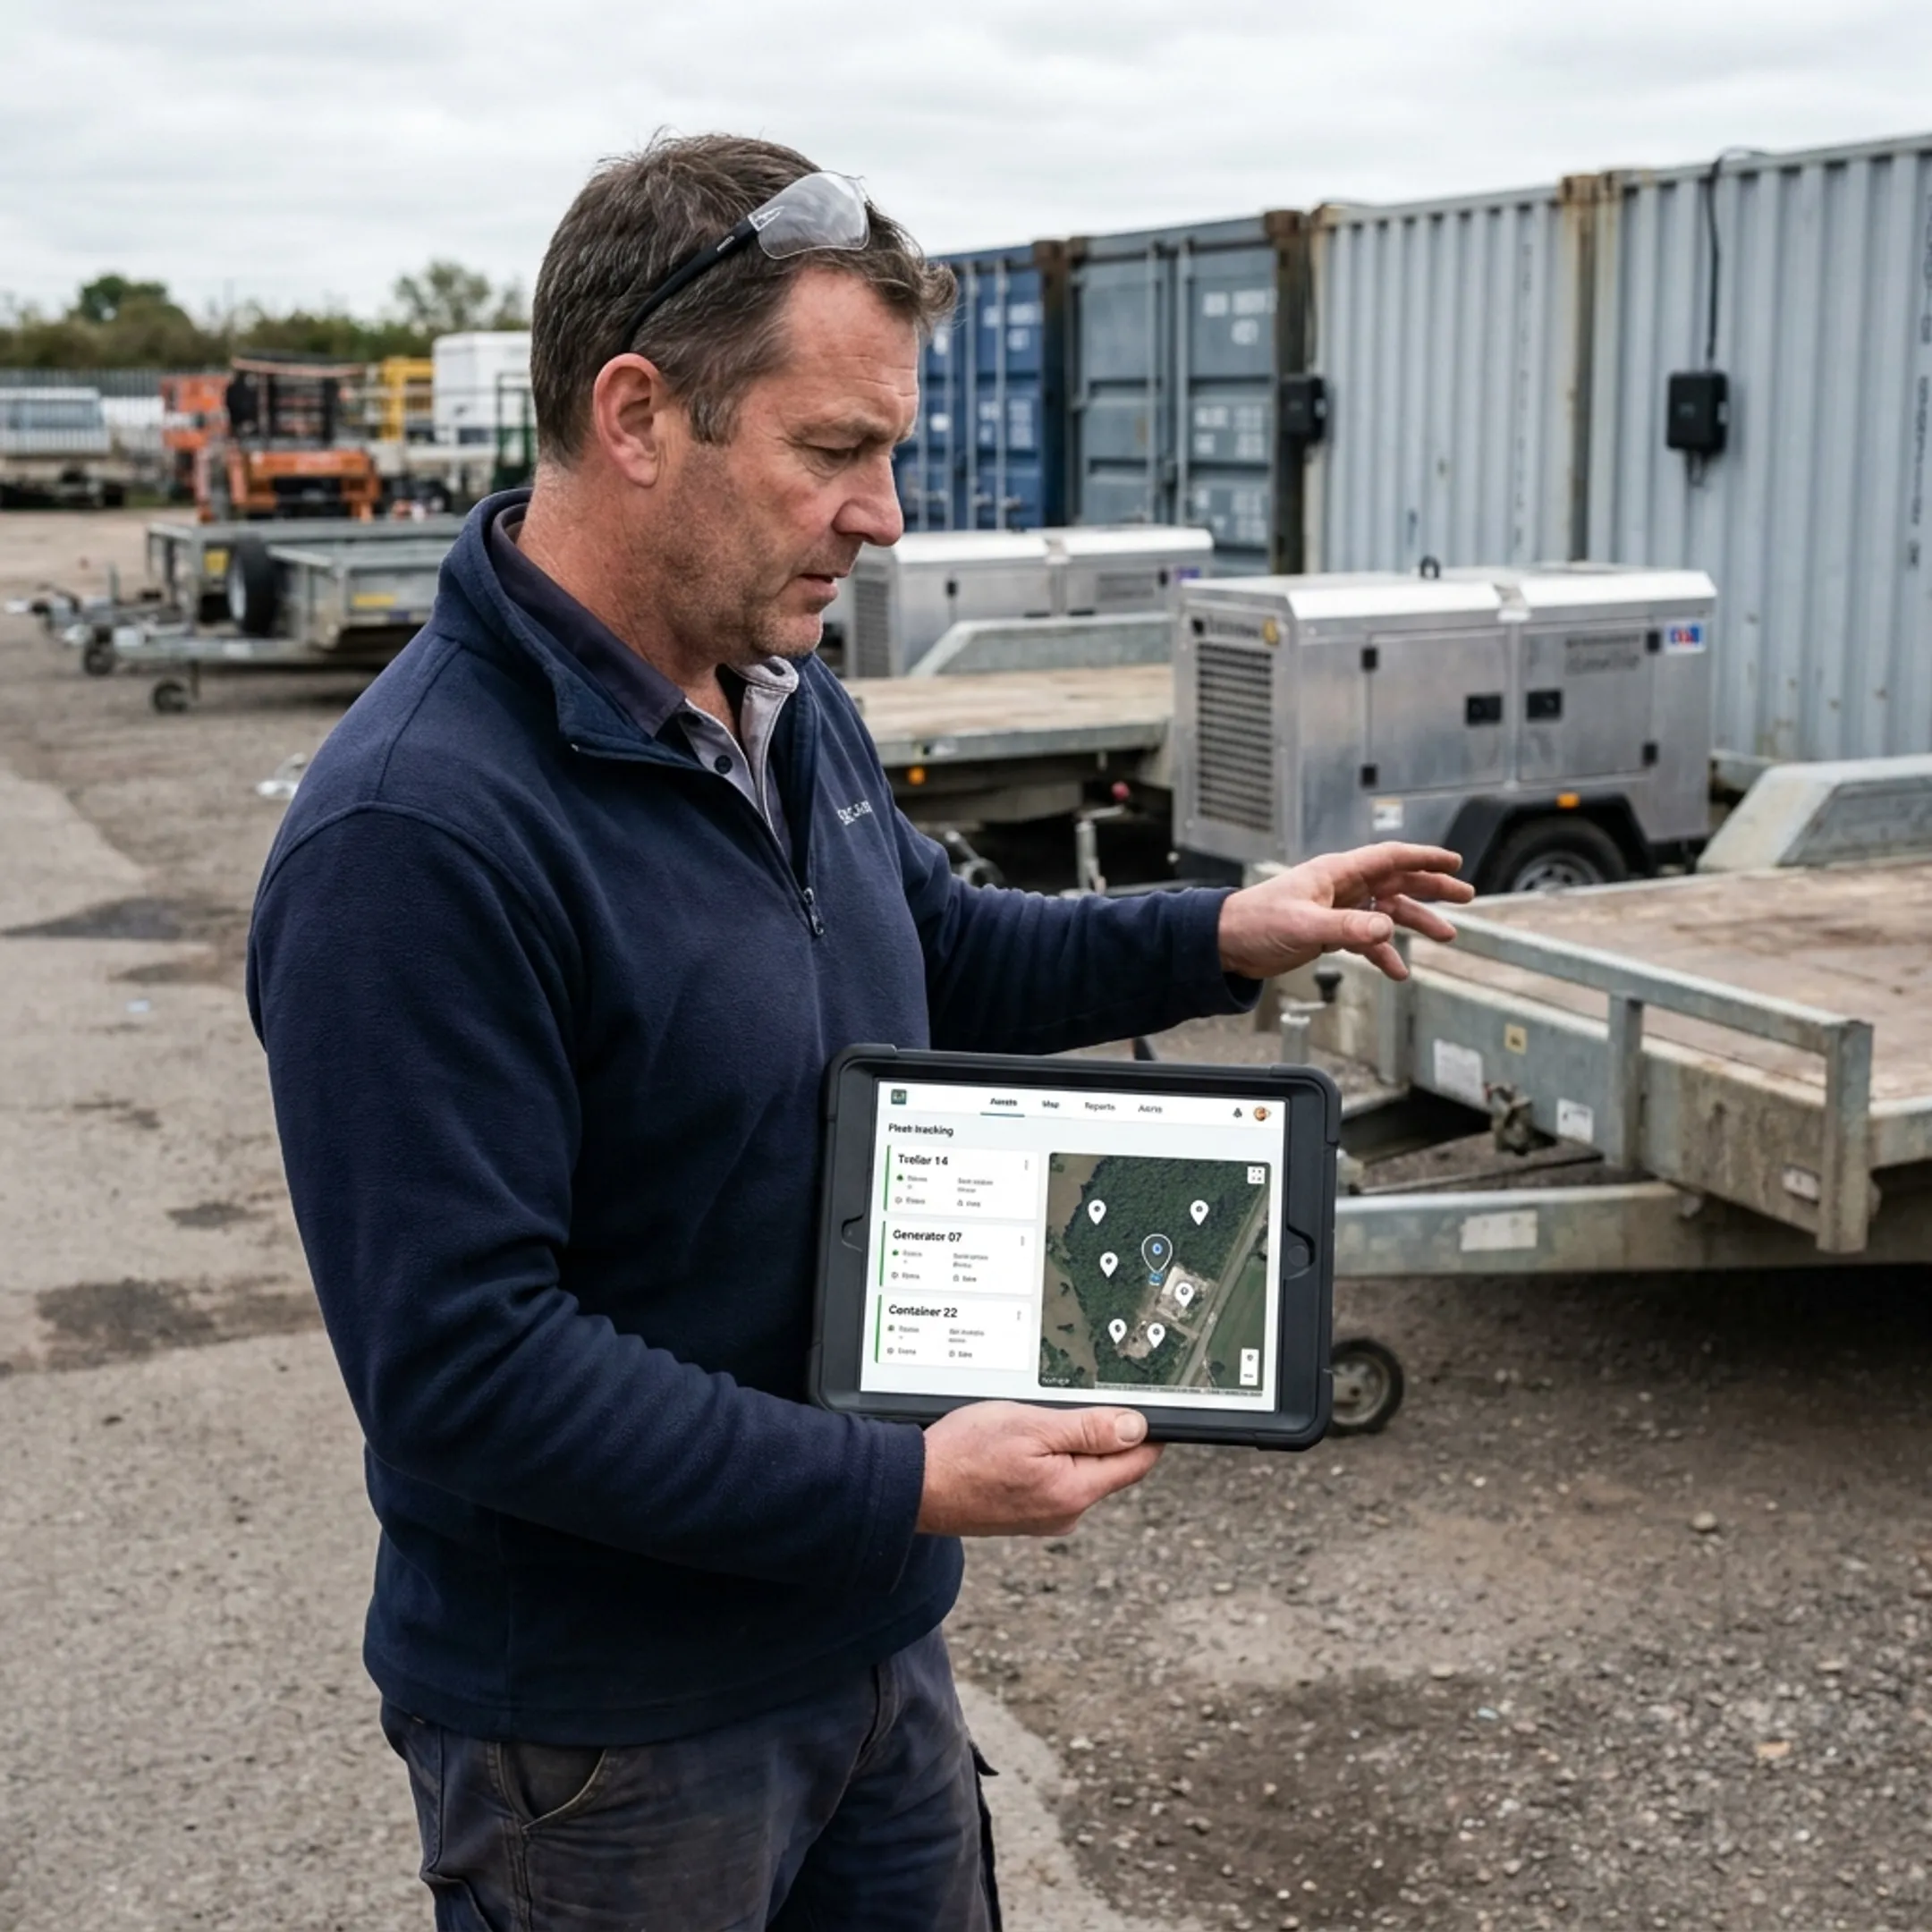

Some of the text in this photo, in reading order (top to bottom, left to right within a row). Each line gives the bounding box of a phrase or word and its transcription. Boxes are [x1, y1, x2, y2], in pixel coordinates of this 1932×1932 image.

[892, 1229, 963, 1242] Generator 07
[888, 1303, 958, 1318] Container 22
